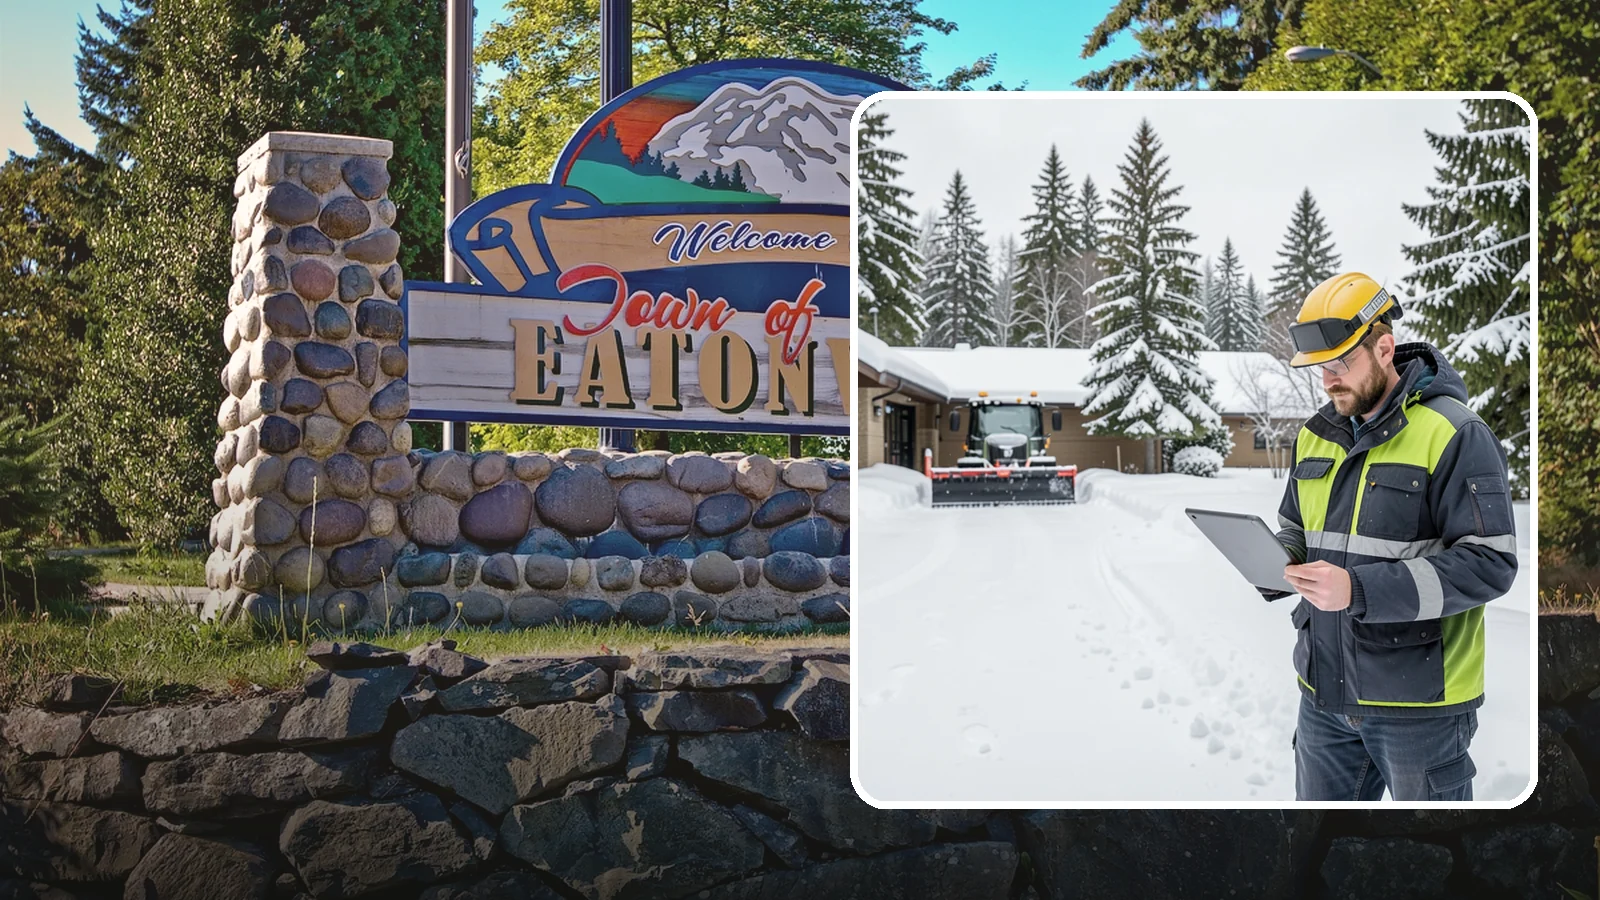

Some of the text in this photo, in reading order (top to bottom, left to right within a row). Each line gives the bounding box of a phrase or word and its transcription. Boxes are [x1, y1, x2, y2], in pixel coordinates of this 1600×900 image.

[653, 220, 836, 262] Welcome
[557, 263, 825, 365] Town of
